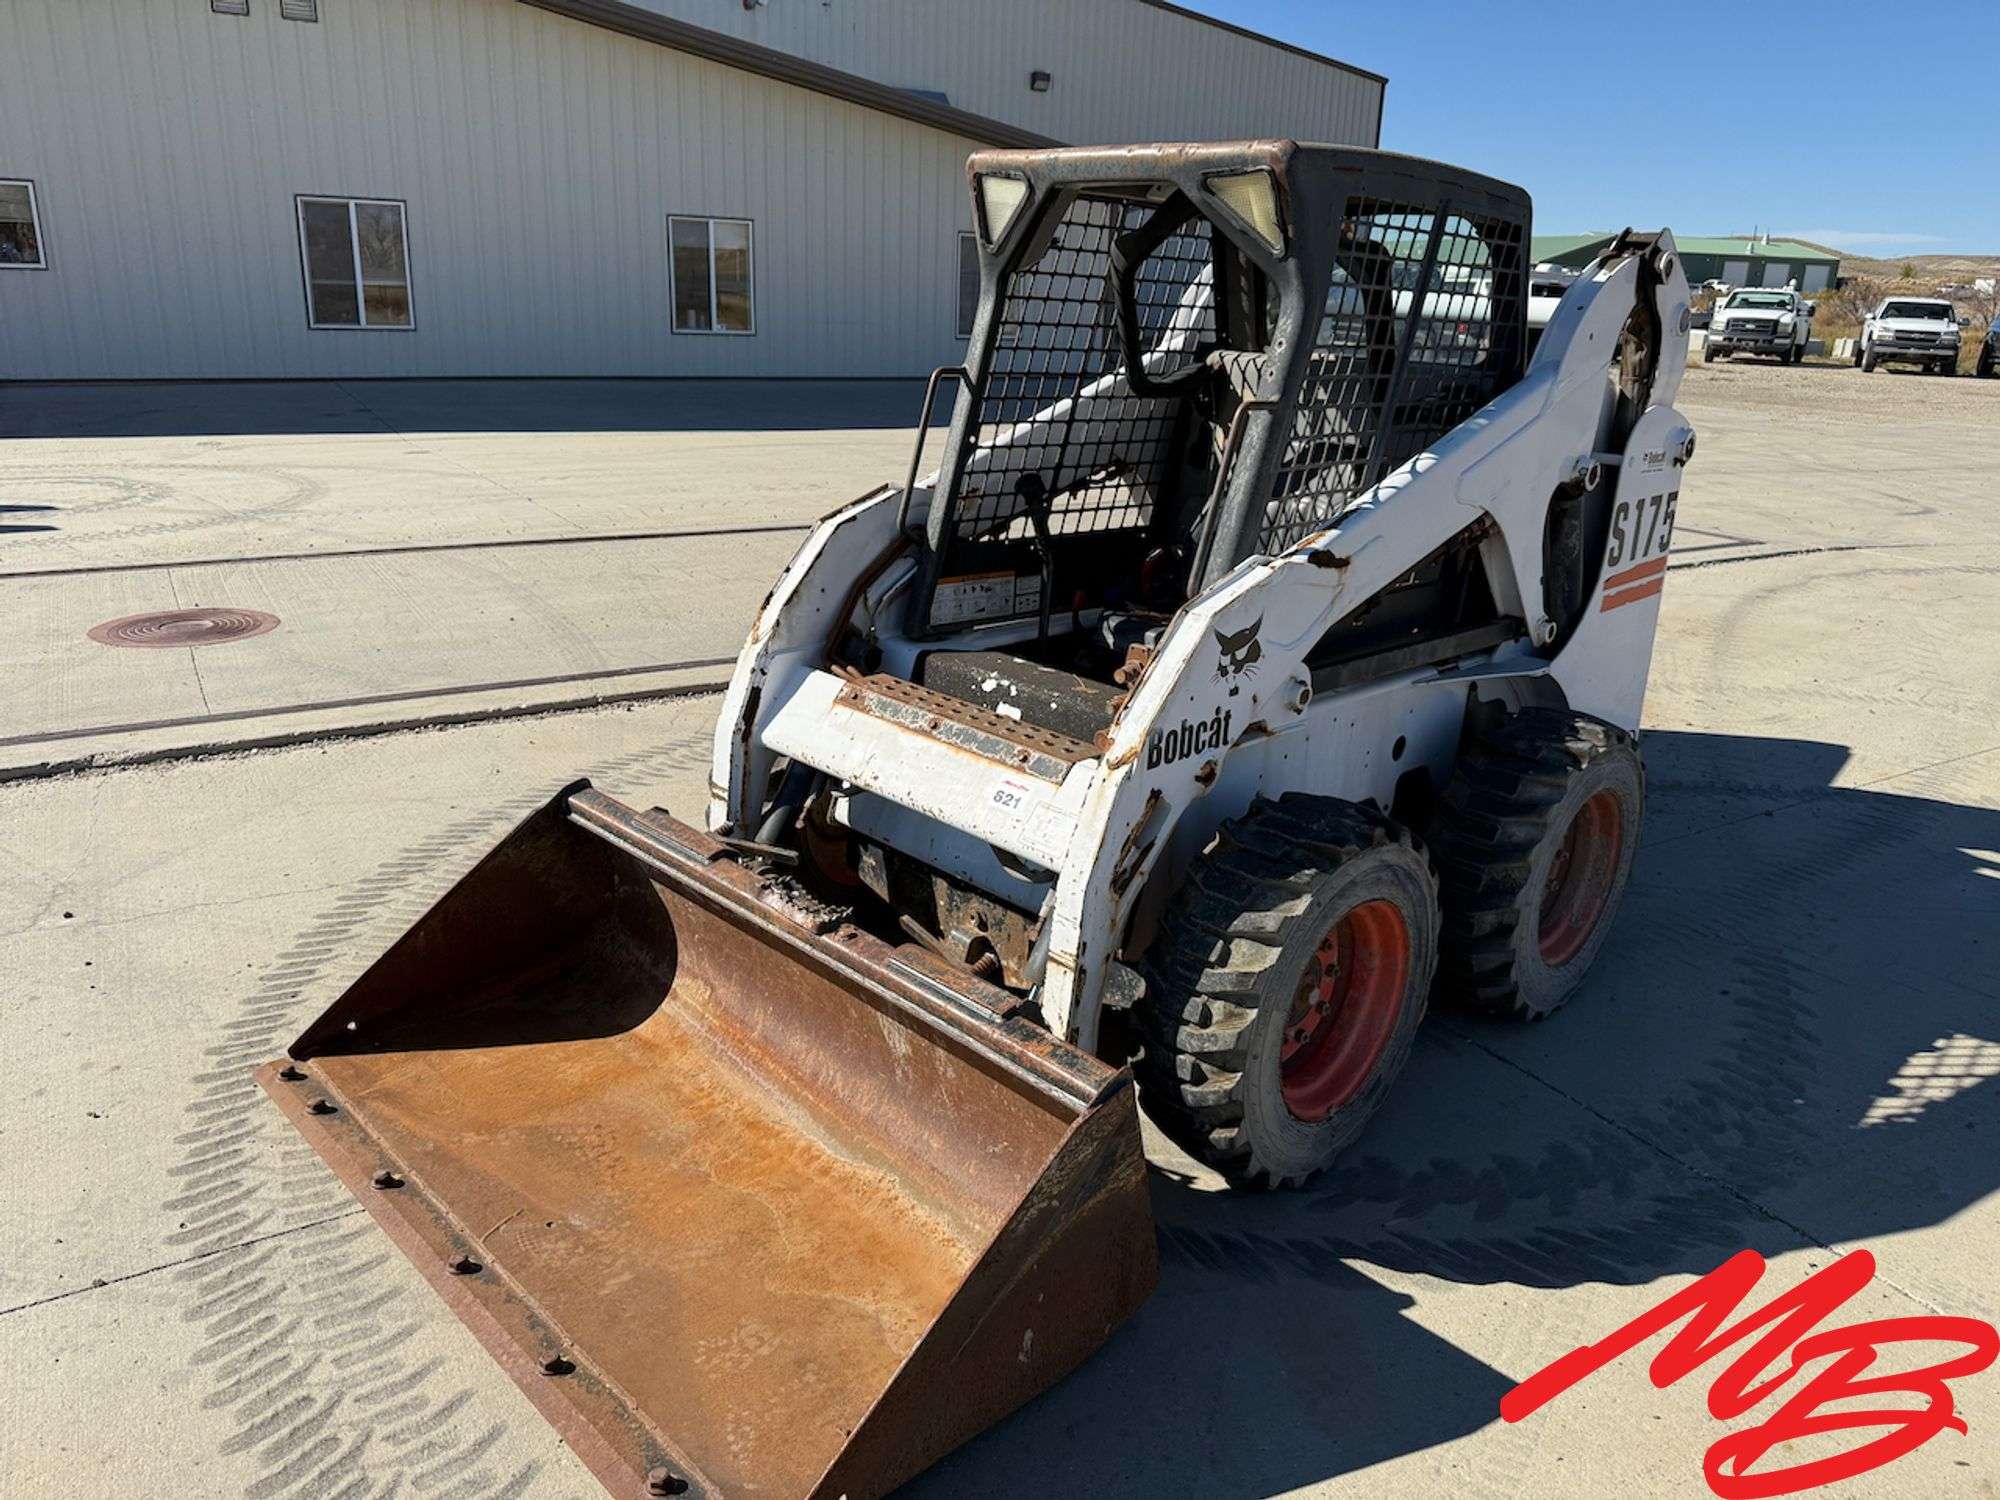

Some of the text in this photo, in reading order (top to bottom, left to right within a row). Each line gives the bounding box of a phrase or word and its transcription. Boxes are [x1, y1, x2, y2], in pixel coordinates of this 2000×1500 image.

[1608, 492, 1678, 567] S175
[1146, 707, 1232, 770] Bobcat
[993, 790, 1022, 809] 621
